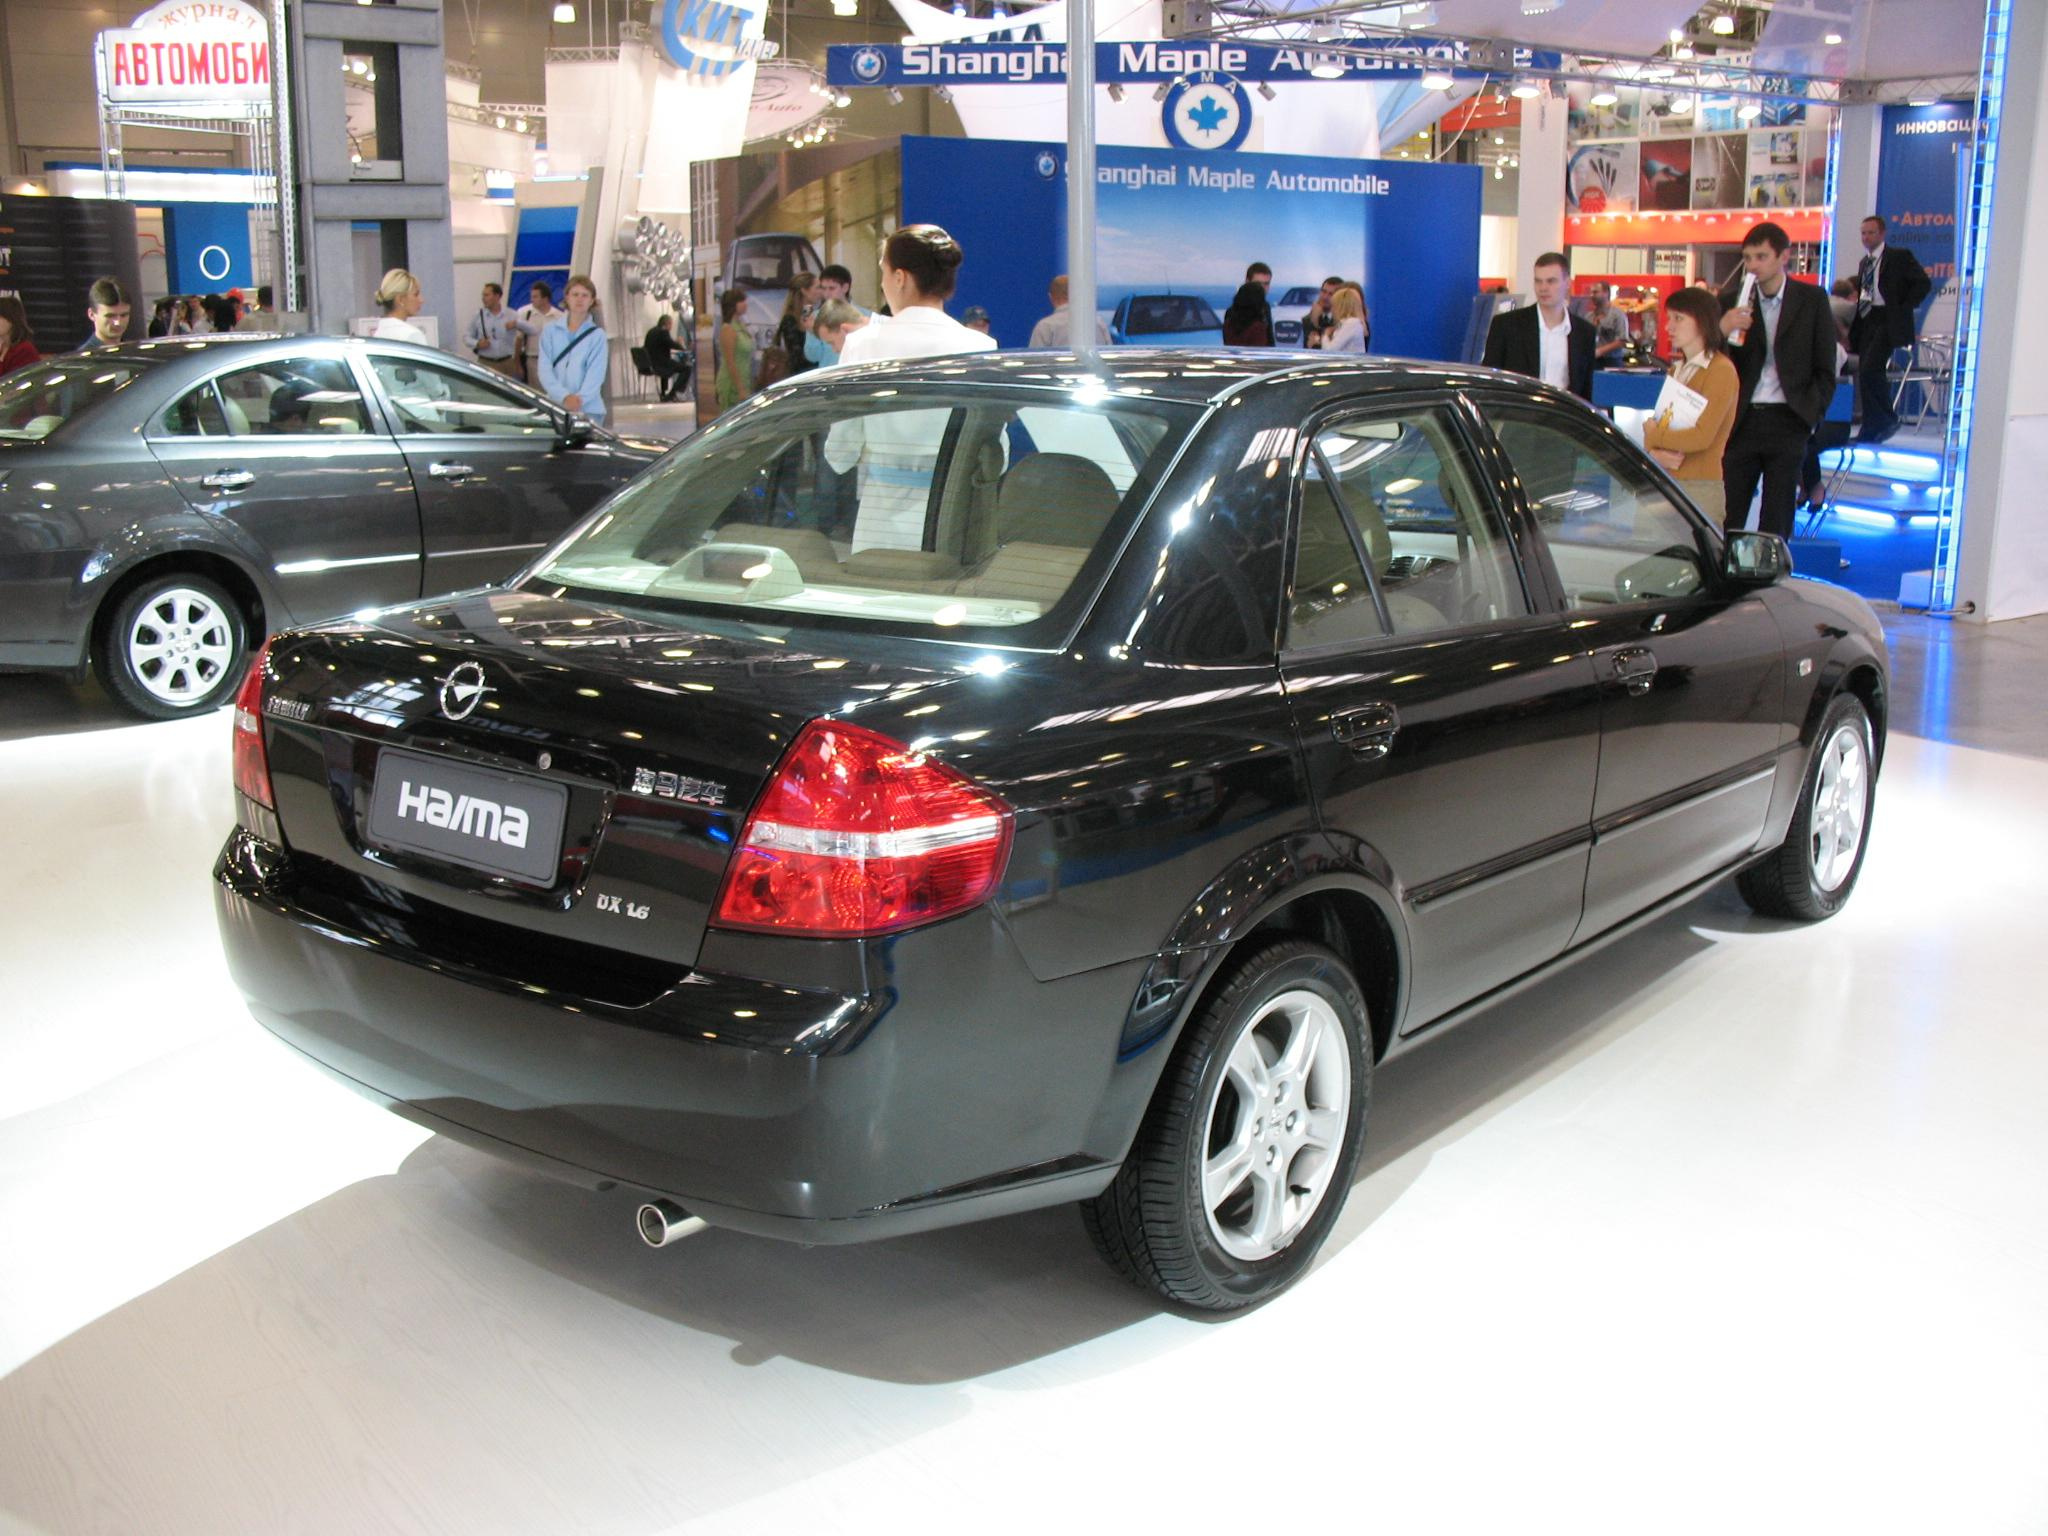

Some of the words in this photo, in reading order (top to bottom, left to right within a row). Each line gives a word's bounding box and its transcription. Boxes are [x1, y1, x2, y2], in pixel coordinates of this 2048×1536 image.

[158, 3, 257, 30] журнал
[114, 42, 270, 86] АВТОМОБИ
[902, 45, 1068, 81] Shangh
[1119, 43, 1248, 74] Maple
[1065, 161, 1177, 190] anghai
[1188, 166, 1255, 193] Maple
[1266, 170, 1390, 196] Automobile
[596, 893, 623, 914] DX
